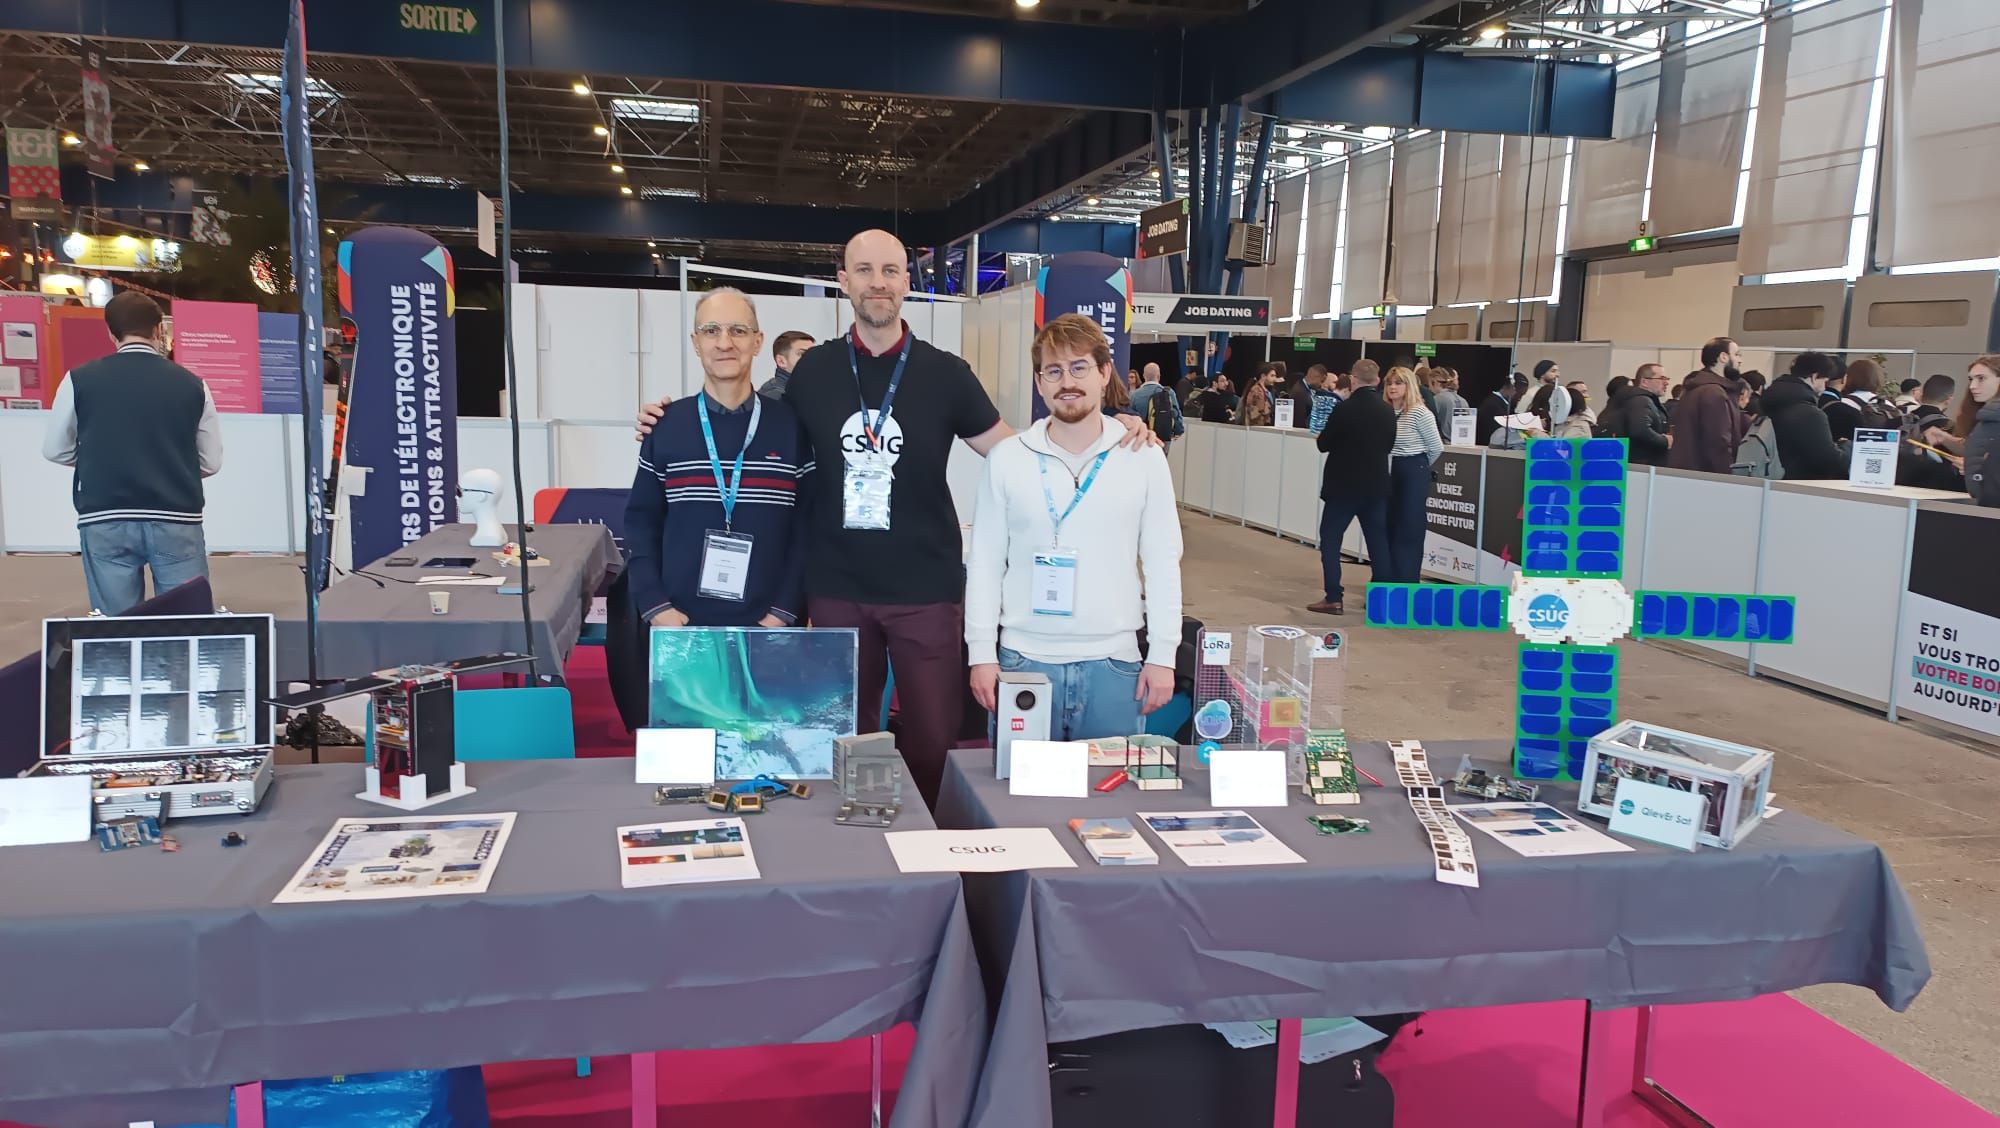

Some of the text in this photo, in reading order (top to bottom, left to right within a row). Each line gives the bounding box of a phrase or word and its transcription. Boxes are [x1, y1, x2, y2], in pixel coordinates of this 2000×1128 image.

[400, 3, 464, 33] SORTIE
[1158, 218, 1179, 235] DATING
[1184, 306, 1252, 318] JOB DATING
[415, 282, 442, 444] ATTRACTIVITÉ
[391, 285, 421, 548] RS DE L'ÉLECTRONIQUE
[841, 433, 903, 455] CSUG
[426, 446, 443, 462] &
[1436, 482, 1463, 497] VENEZ
[1447, 515, 1475, 531] FUTUR
[1528, 608, 1569, 623] CSUG
[1920, 622, 1958, 642] ET SI
[1203, 640, 1231, 650] LoRa
[1918, 641, 2000, 673] VOUS TRO
[1916, 661, 1969, 686] VOTRE
[1913, 681, 2000, 717] AUJOURD'
[949, 845, 1006, 854] CSUG
